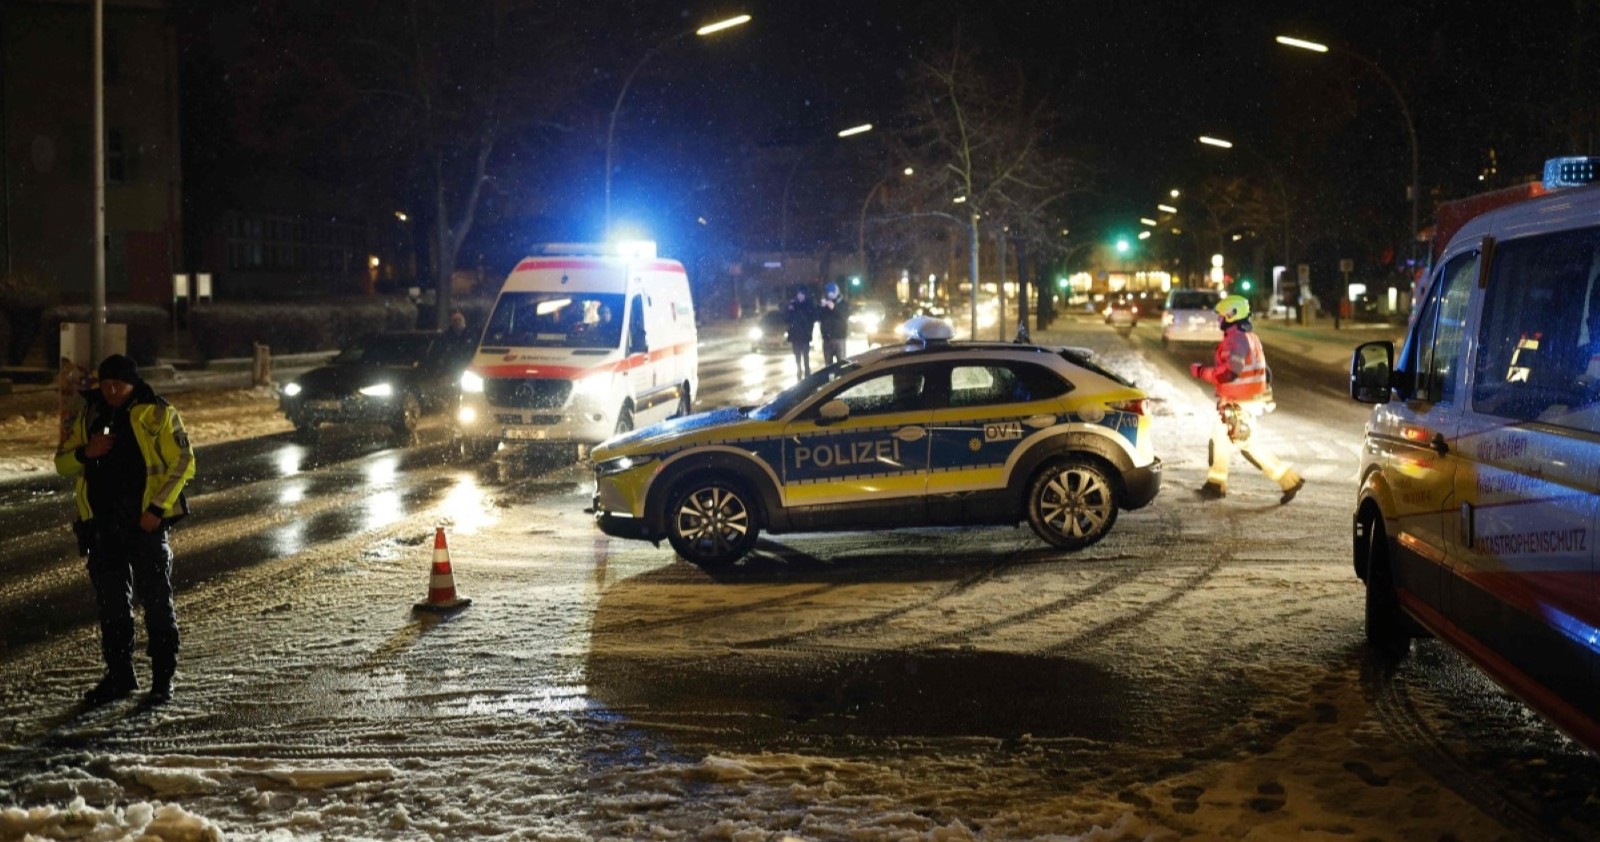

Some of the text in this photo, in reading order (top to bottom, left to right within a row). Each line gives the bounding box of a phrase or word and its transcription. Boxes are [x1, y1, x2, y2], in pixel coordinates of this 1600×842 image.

[986, 422, 1018, 439] OV 4
[795, 438, 900, 469] POLIZEI
[1475, 528, 1587, 555] KATASTROPHENSCHUTZ
